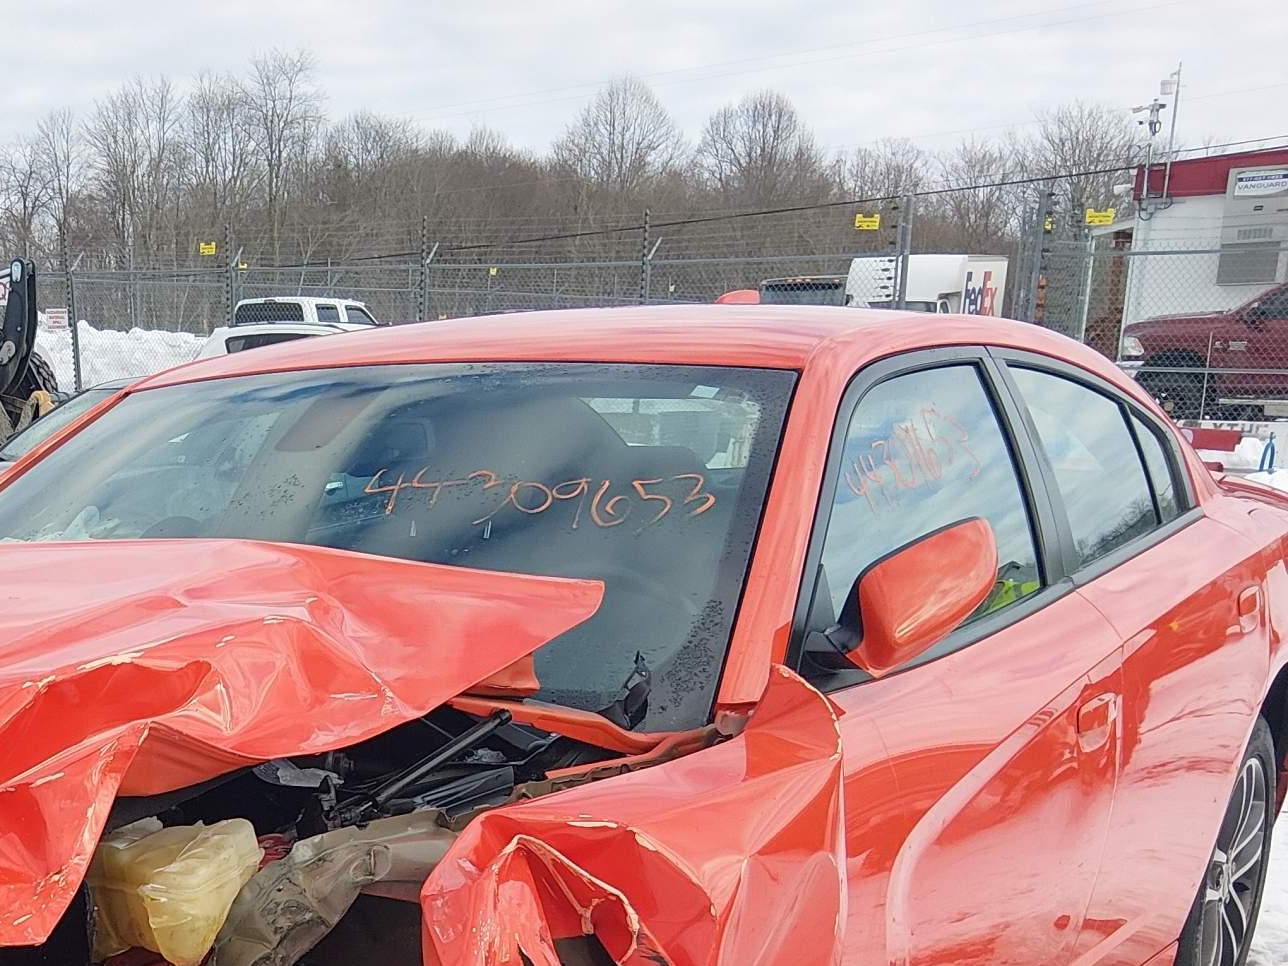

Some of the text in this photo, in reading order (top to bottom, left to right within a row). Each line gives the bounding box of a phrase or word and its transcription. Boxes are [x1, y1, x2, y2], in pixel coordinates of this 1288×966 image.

[1238, 181, 1288, 190] VANGUARD
[963, 271, 997, 317] FedEx
[364, 466, 716, 535] 44309653
